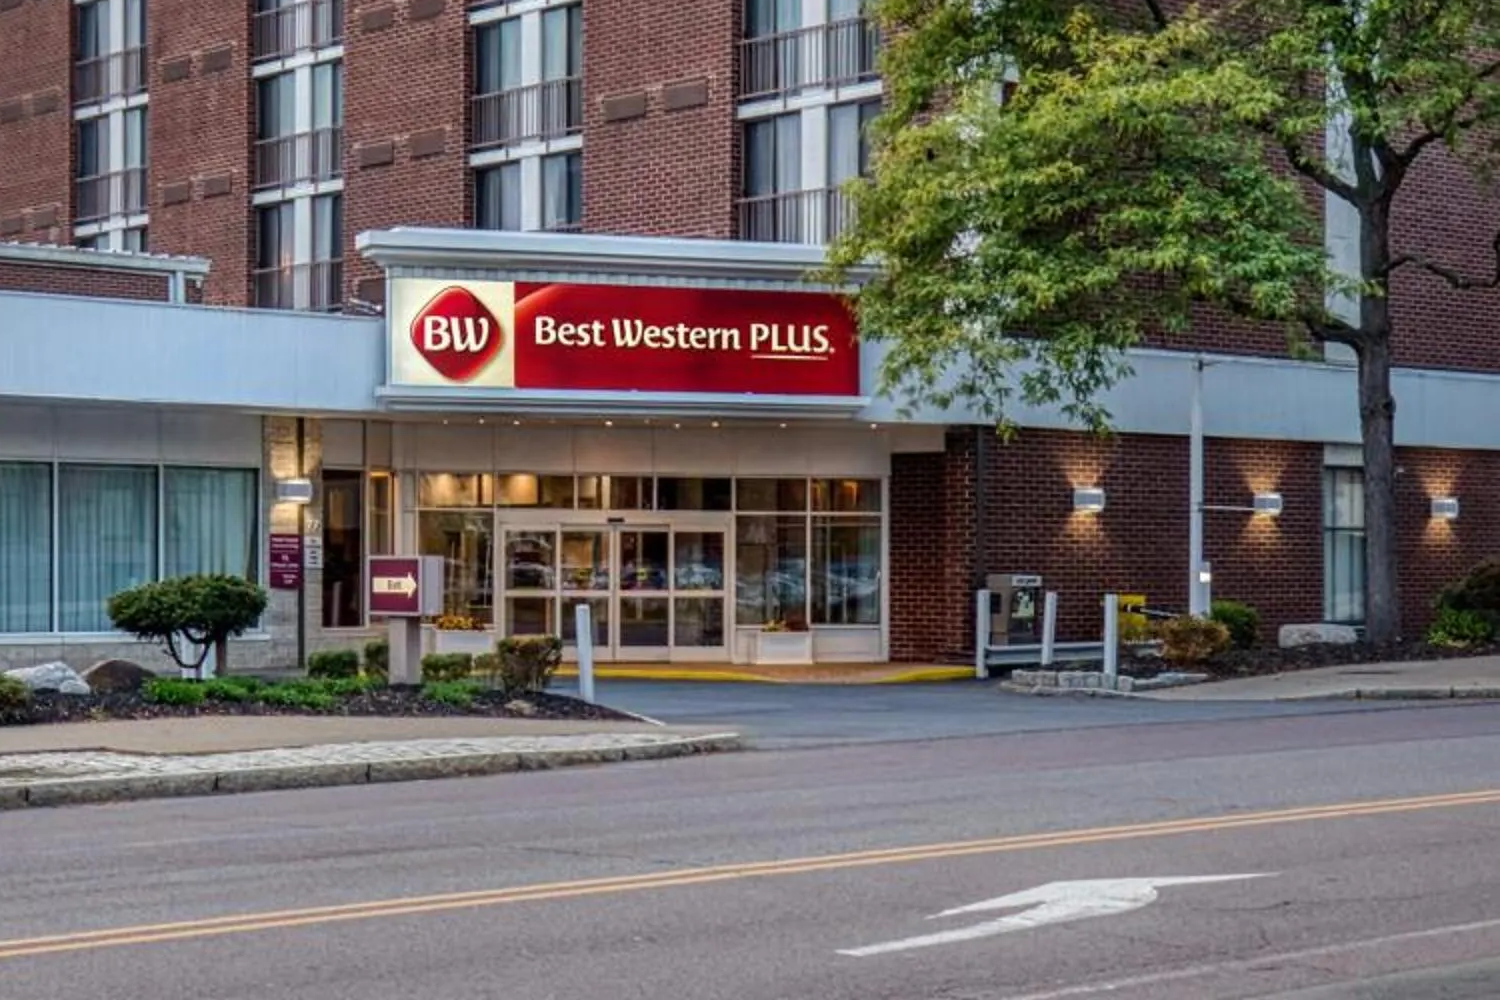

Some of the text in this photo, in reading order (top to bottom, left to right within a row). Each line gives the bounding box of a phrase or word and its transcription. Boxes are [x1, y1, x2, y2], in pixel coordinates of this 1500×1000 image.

[424, 315, 489, 352] BW
[535, 316, 606, 347] Best
[612, 319, 741, 350] Western
